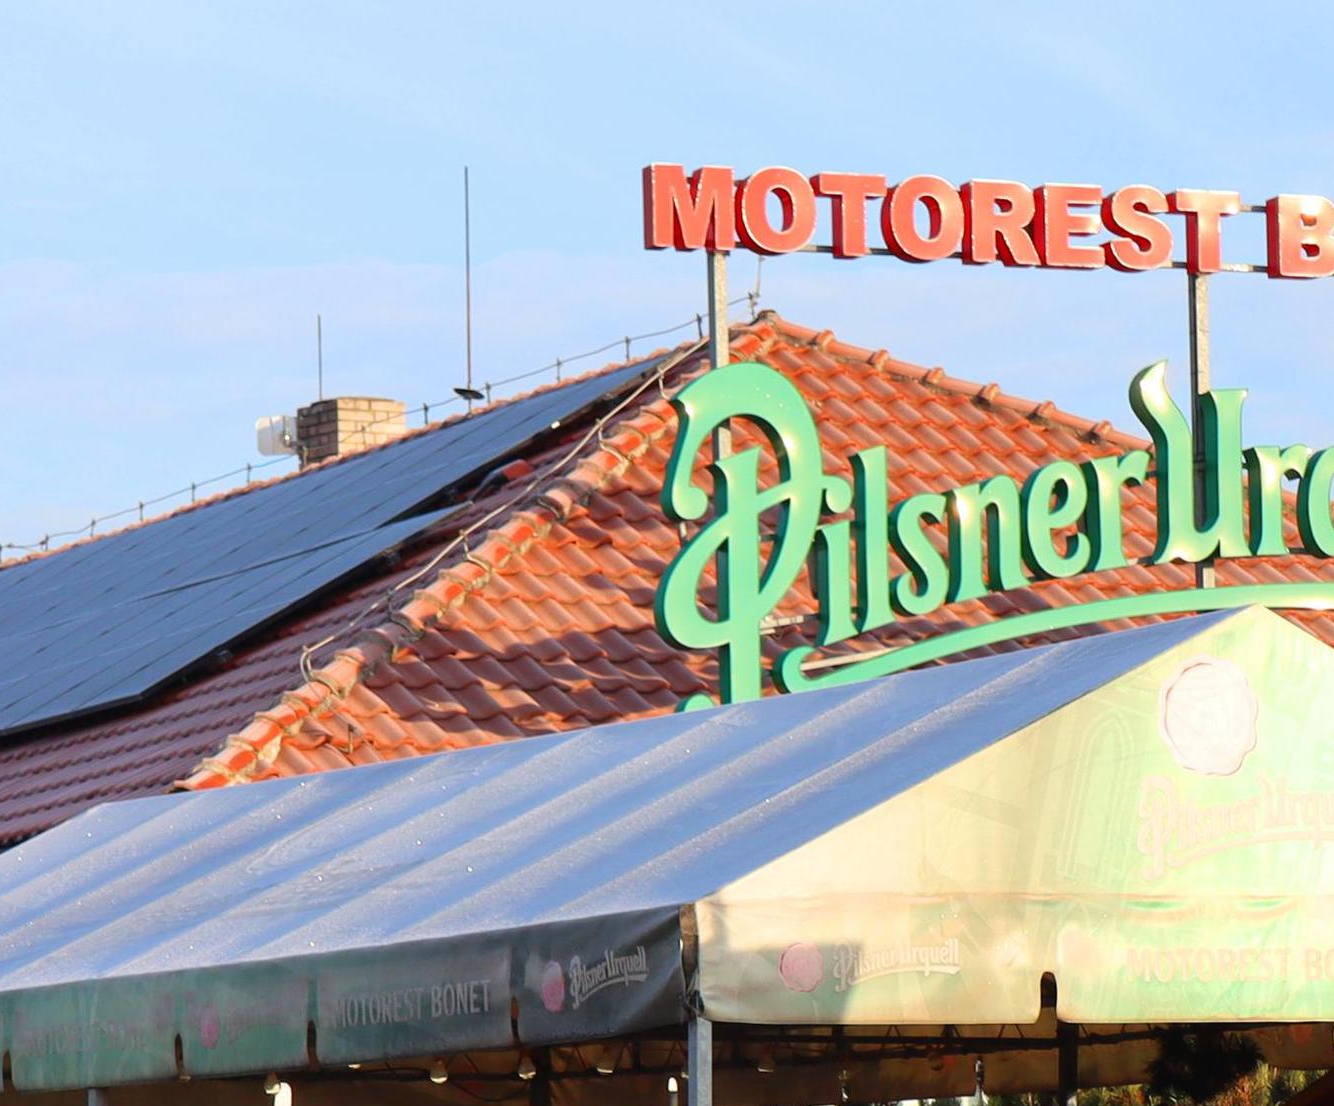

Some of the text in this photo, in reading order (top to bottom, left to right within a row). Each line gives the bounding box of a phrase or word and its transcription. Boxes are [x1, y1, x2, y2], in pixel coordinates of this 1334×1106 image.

[643, 163, 1241, 274] MOTOREST
[654, 361, 1154, 706] Pilsner
[1137, 773, 1259, 880] Pilsner
[334, 987, 424, 1028] MOTOREST
[430, 979, 492, 1018] BONET
[833, 937, 960, 992] Pilsner Urquell
[1126, 948, 1291, 982] MOTOREST
